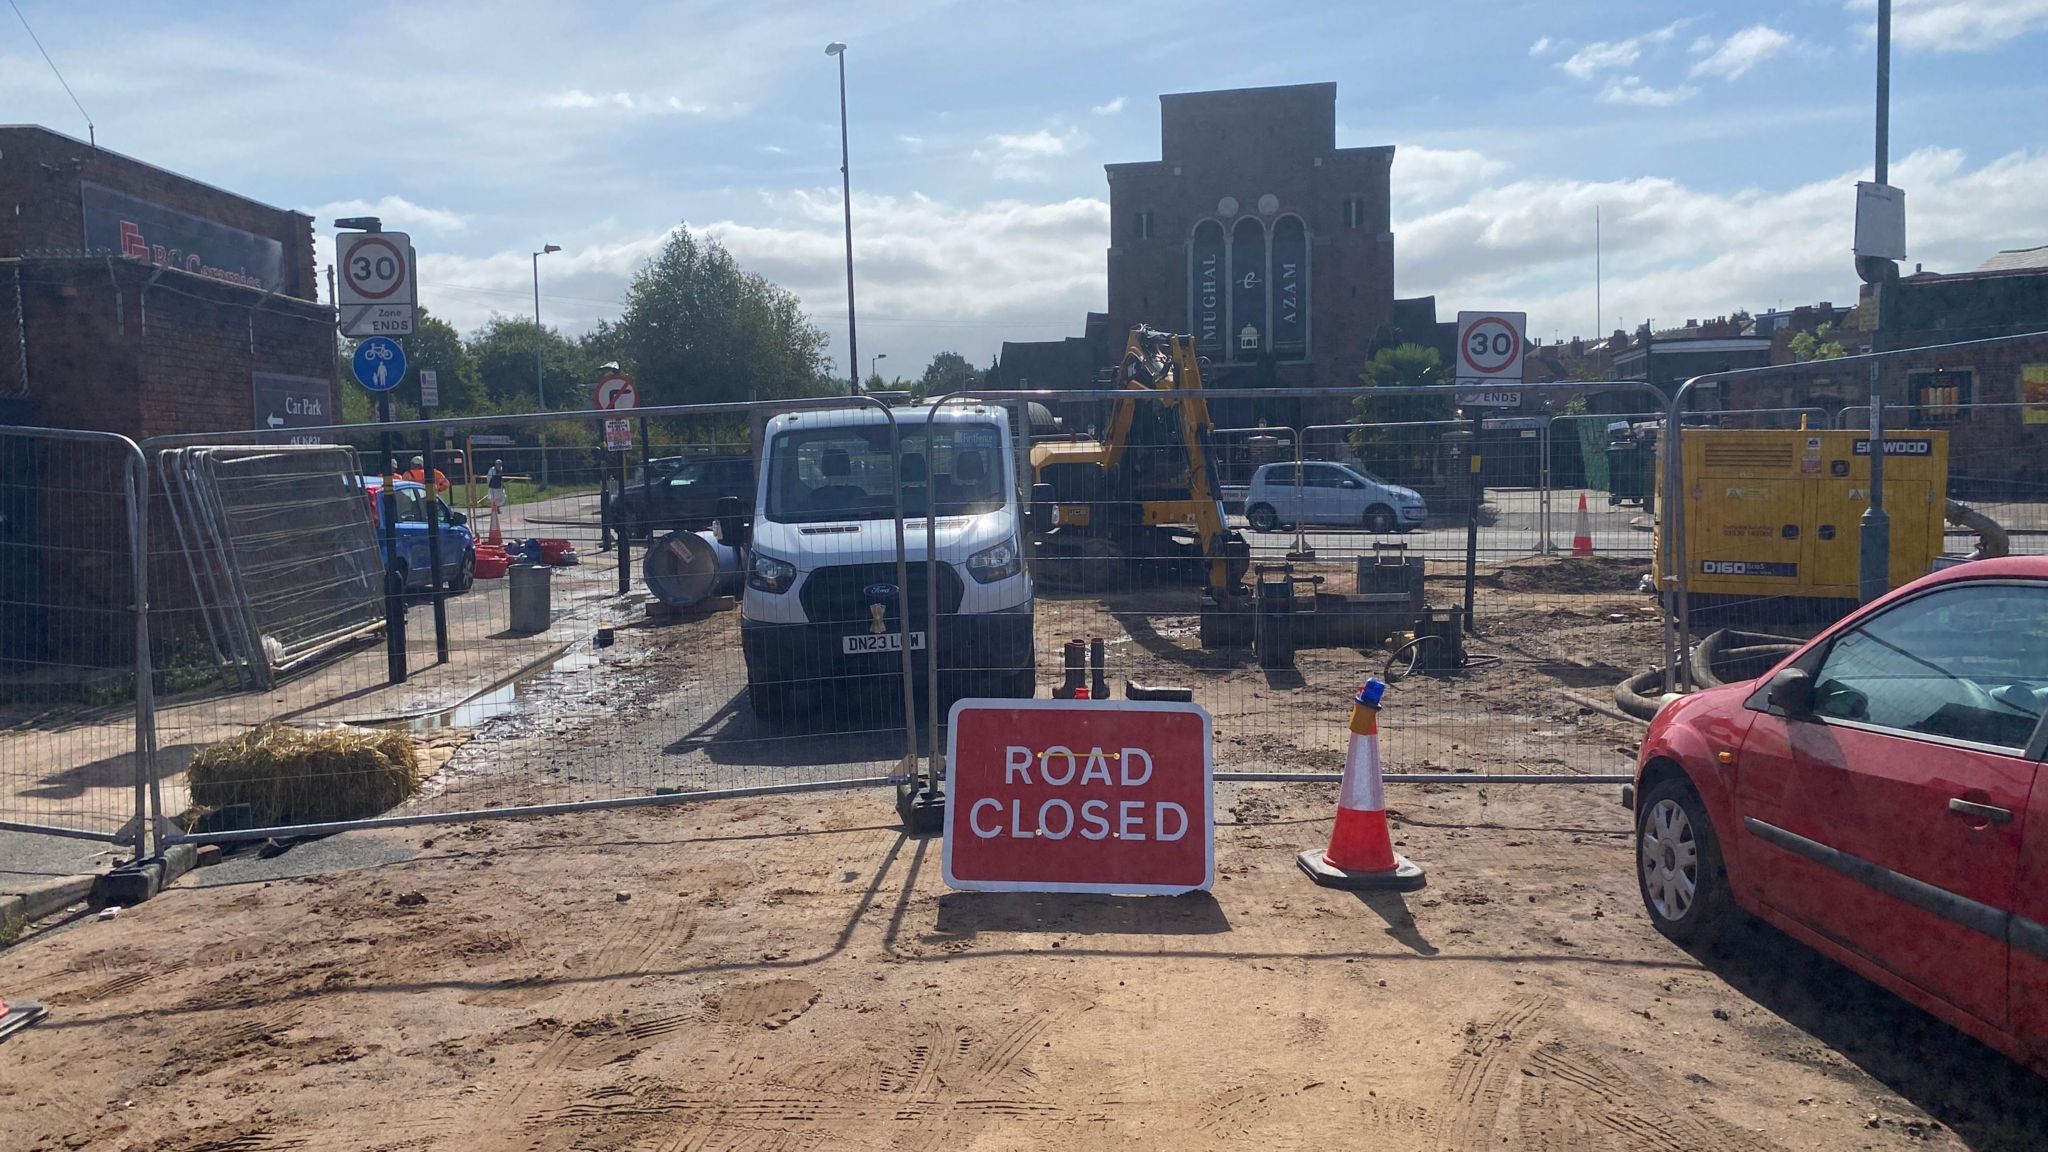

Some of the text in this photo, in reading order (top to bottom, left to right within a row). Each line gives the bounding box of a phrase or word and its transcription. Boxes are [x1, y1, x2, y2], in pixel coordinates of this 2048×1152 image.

[353, 256, 395, 281] 30
[1203, 254, 1216, 340] MUGHAL
[1283, 264, 1296, 323] AZAM
[379, 309, 402, 318] Zone
[373, 321, 409, 331] ENDS
[1471, 332, 1511, 356] 30
[286, 397, 322, 416] Car Park
[1484, 392, 1518, 403] ENDS
[1856, 441, 1928, 454] SWOOD
[1703, 561, 1746, 574] D160
[871, 585, 891, 594] Ford
[849, 634, 919, 651] DN23 LW
[1005, 745, 1153, 787] ROAD
[969, 797, 1189, 842] CLOSED
